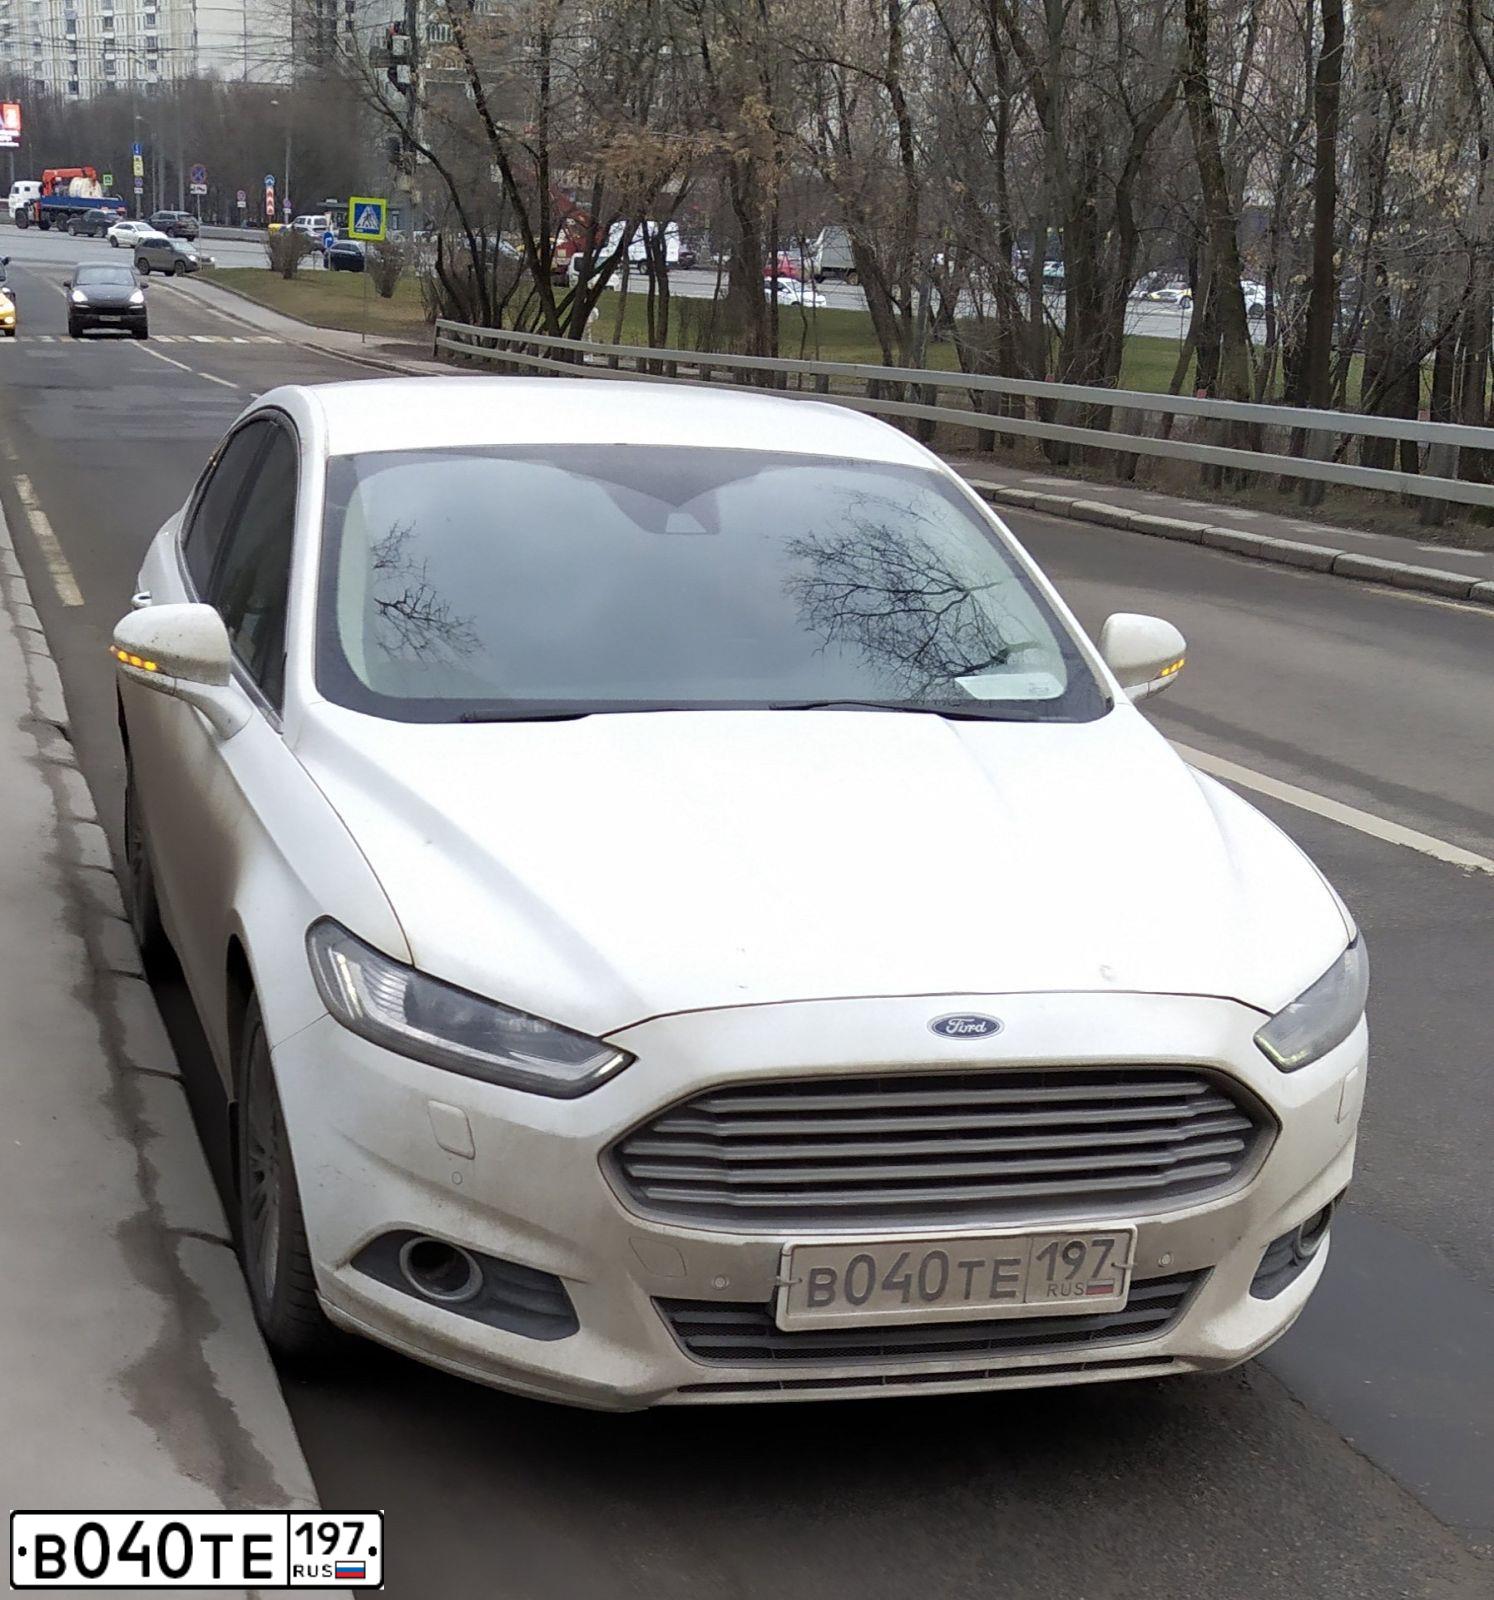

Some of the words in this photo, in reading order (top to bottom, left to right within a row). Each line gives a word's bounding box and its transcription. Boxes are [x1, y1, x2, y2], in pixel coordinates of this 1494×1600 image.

[945, 1018, 987, 1033] Ford
[1036, 1239, 1115, 1283] 197
[1047, 1281, 1084, 1296] RUS
